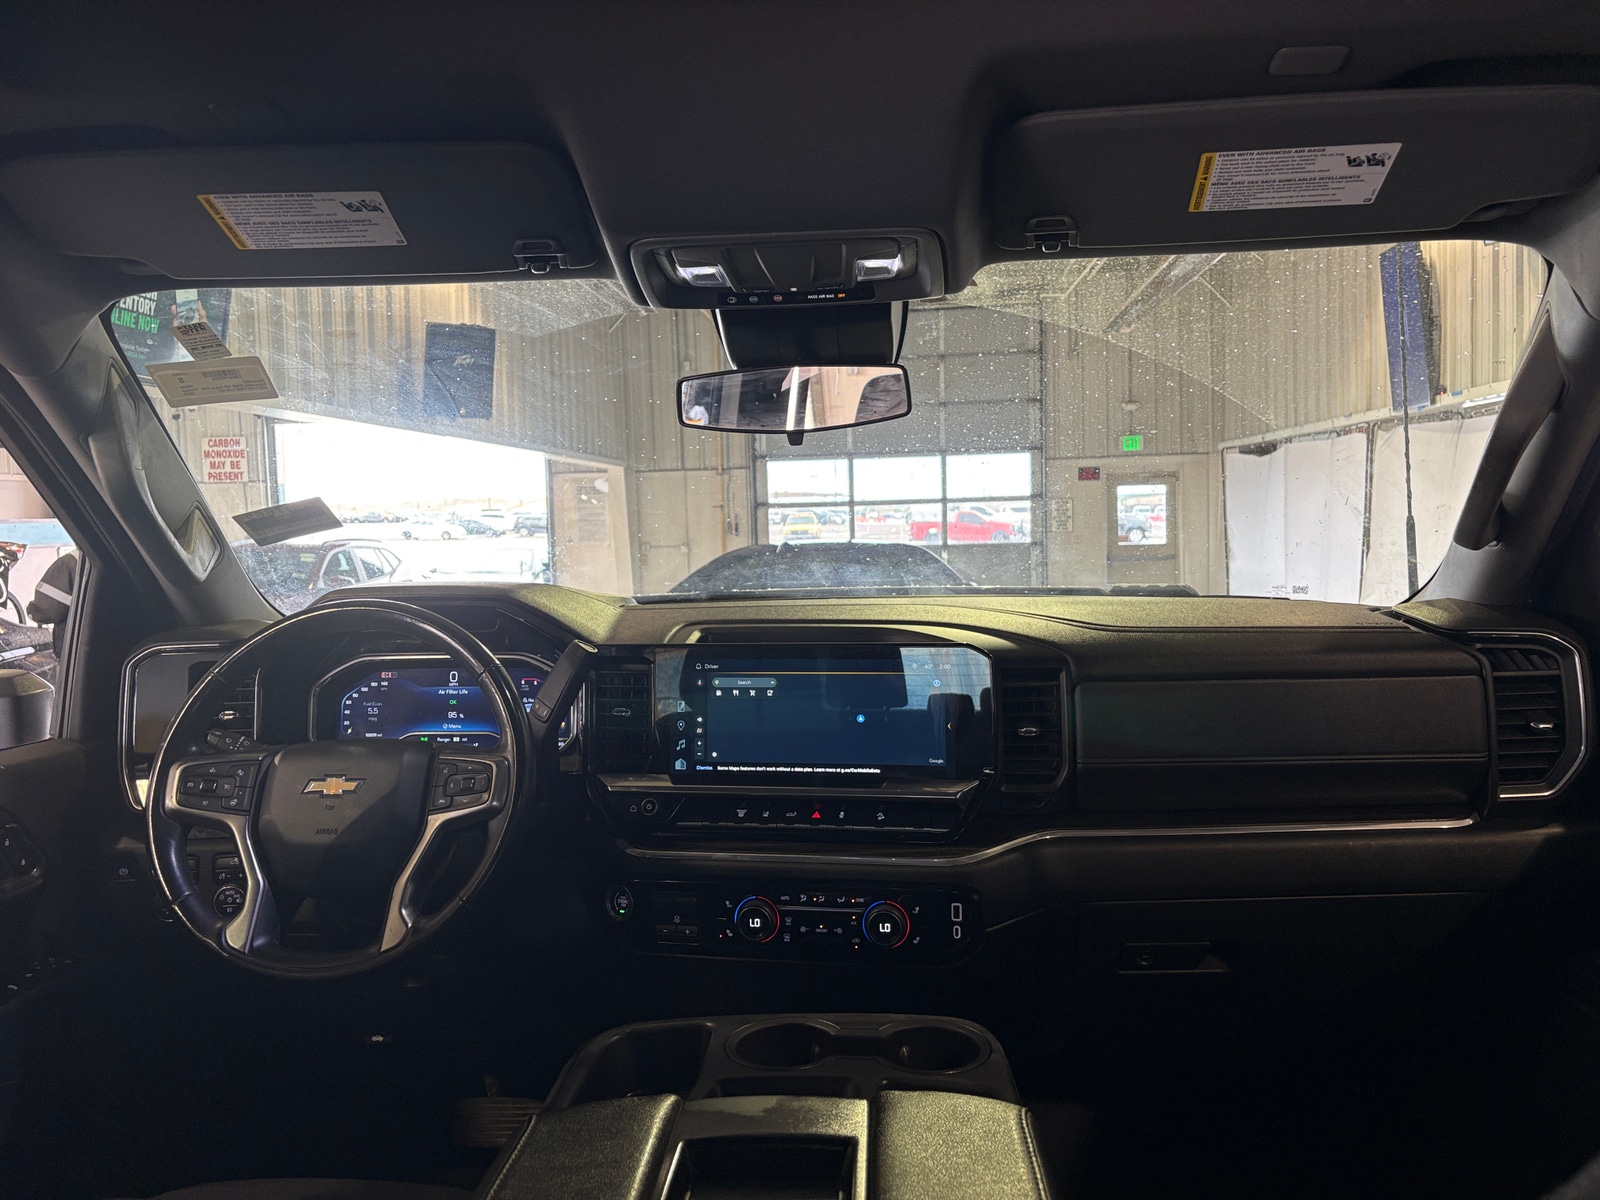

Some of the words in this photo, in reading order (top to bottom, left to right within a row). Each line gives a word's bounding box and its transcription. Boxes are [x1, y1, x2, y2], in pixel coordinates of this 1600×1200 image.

[116, 296, 157, 316] ENTORY
[138, 314, 160, 334] NOW
[207, 438, 241, 448] CARBON
[203, 449, 246, 459] MONOXIDE
[209, 460, 226, 470] MAY
[230, 460, 241, 470] BE
[207, 471, 244, 481] PRESENT
[449, 671, 458, 682] 0
[367, 707, 379, 715] 5.5
